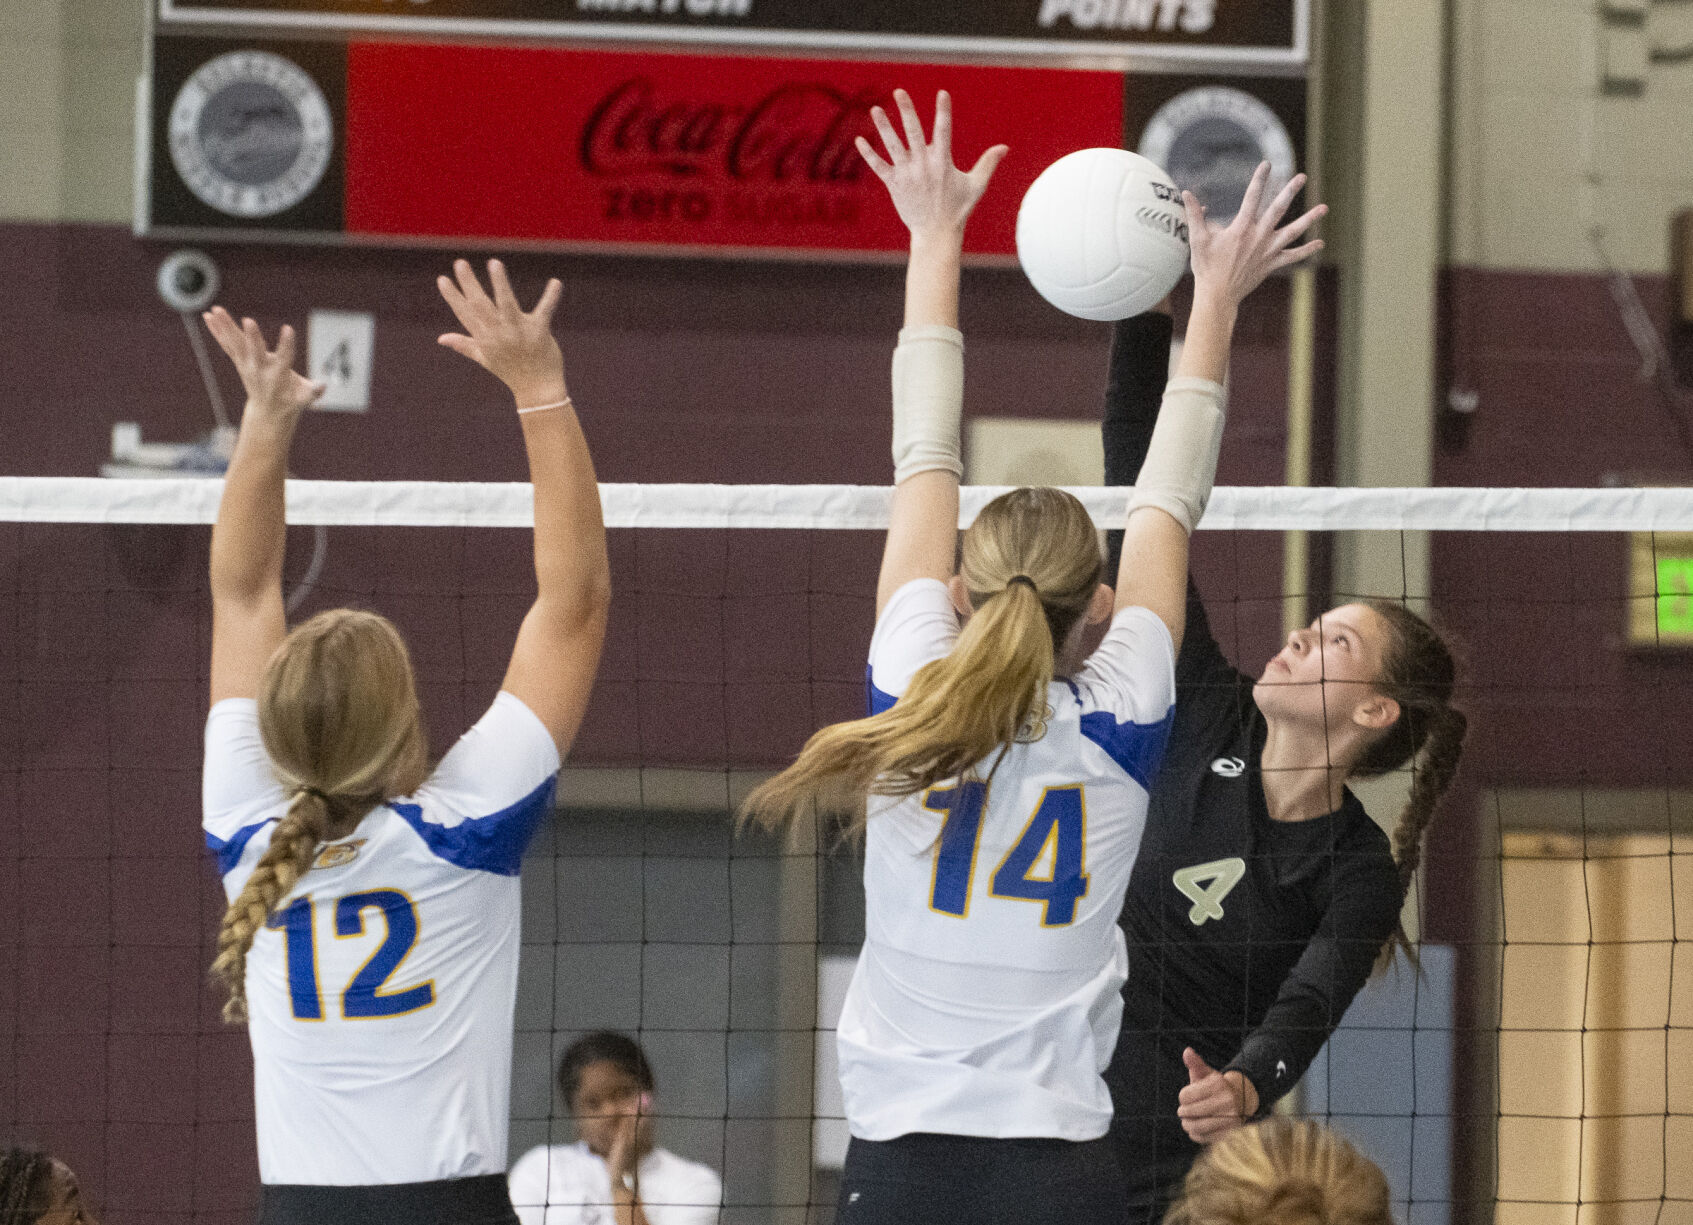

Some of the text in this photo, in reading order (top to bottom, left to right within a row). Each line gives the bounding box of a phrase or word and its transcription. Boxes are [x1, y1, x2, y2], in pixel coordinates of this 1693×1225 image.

[604, 186, 711, 223] zero
[321, 340, 353, 382] 4
[922, 777, 1090, 928] 14
[1173, 857, 1245, 926] 4
[266, 887, 437, 1022] 12
